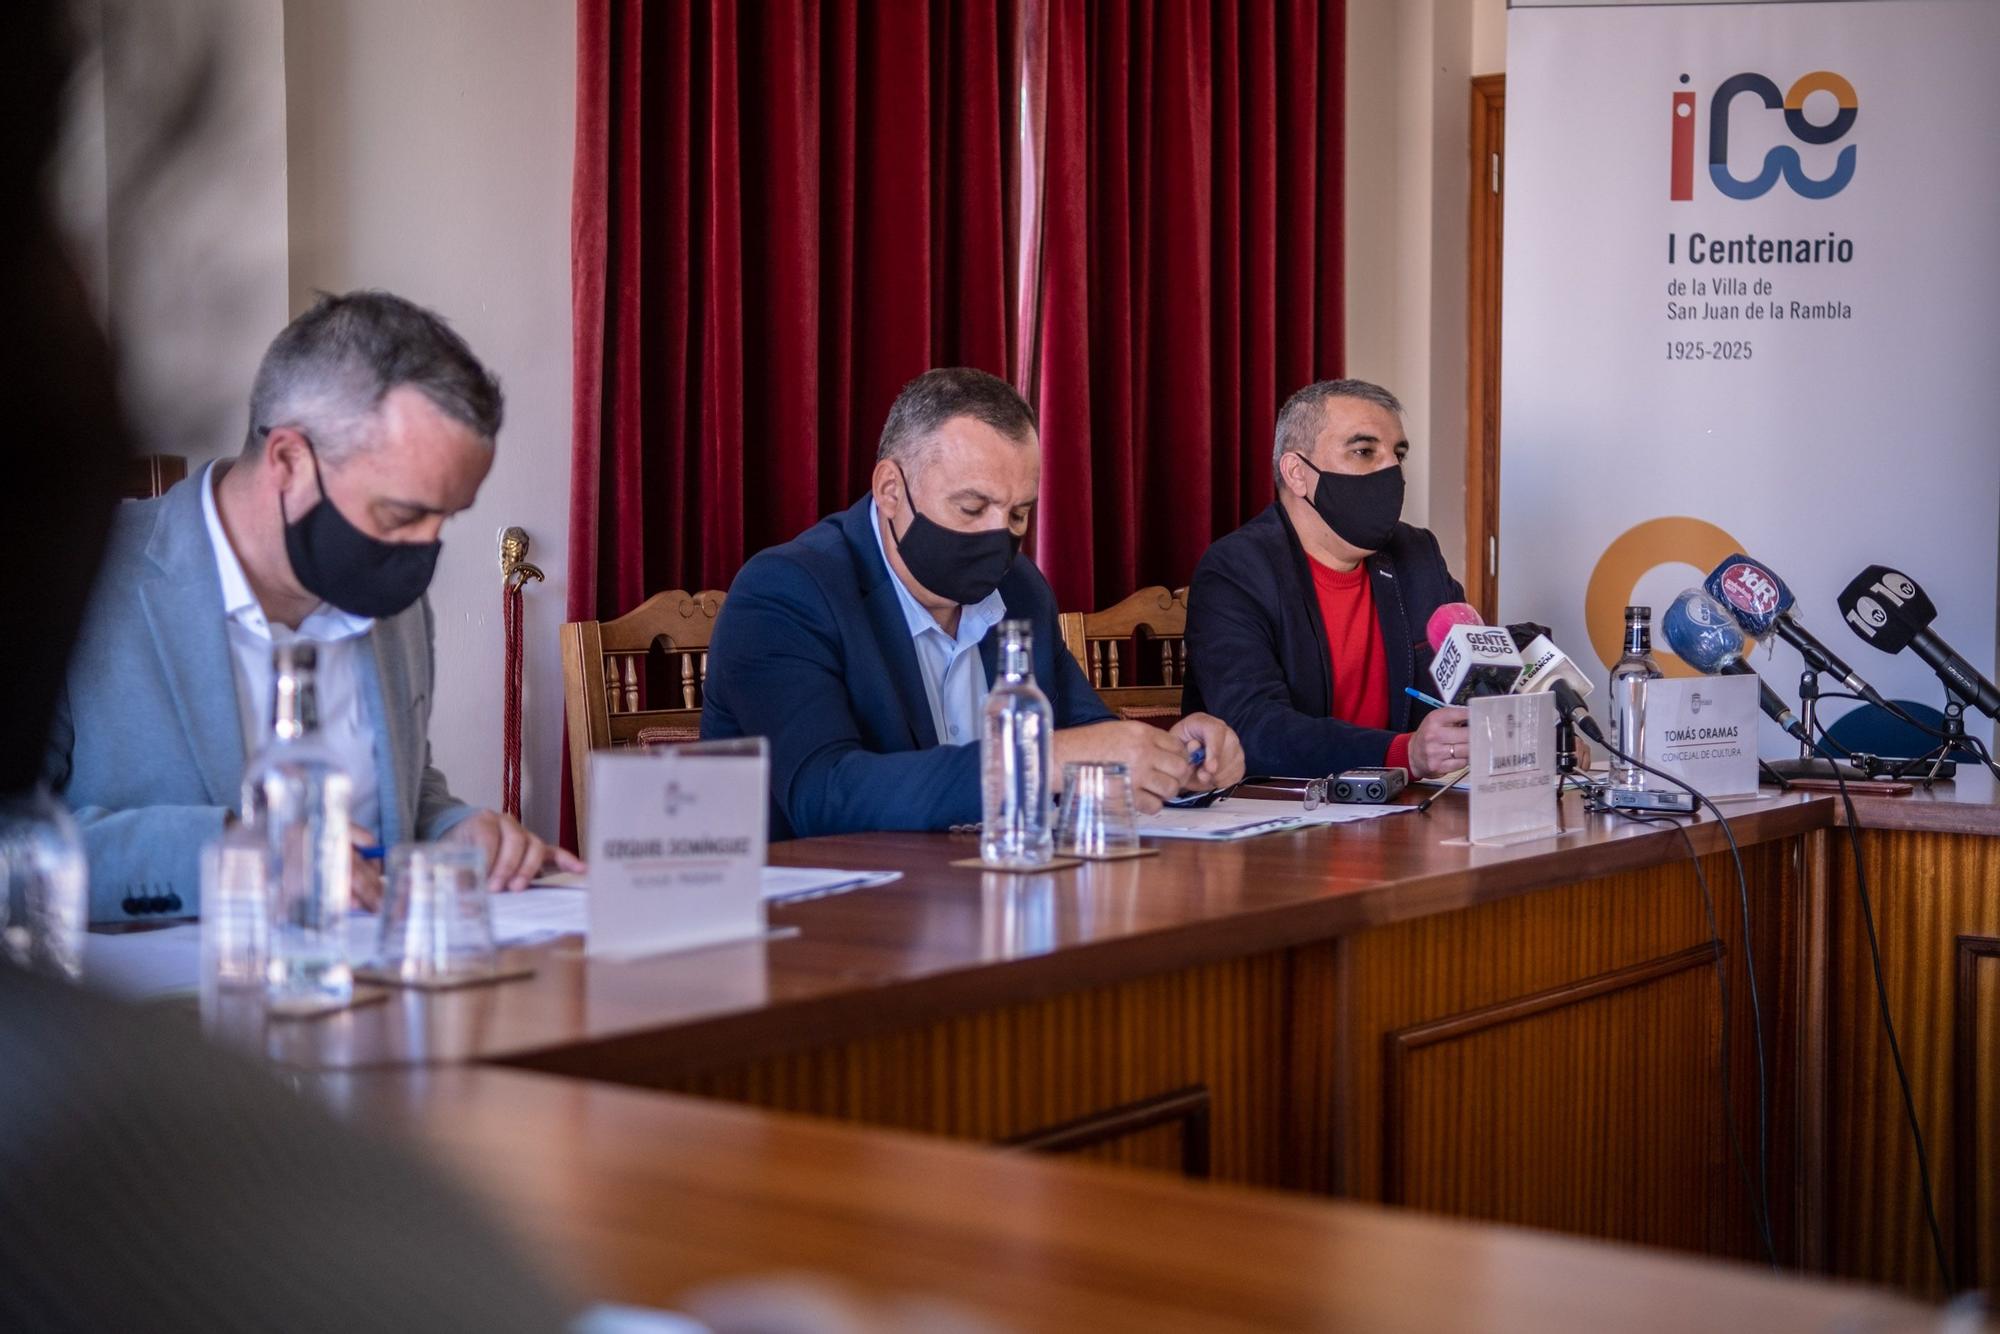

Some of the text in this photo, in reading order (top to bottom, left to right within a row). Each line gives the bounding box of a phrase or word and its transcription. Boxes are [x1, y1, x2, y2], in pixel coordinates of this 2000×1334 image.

[1668, 232, 1854, 264] I Centenario
[1667, 278, 1772, 296] de la Villa de
[1667, 301, 1851, 320] San Juan de la Rambla
[1666, 341, 1753, 360] 1925-2025
[1466, 632, 1510, 647] GENTE
[1471, 644, 1513, 654] RADIO
[1435, 640, 1458, 682] GENTE
[1441, 652, 1461, 690] RADIO
[1665, 726, 1738, 742] TOMÁS ORAMAS
[1662, 747, 1741, 762] CONCEJAL DE CULTURA
